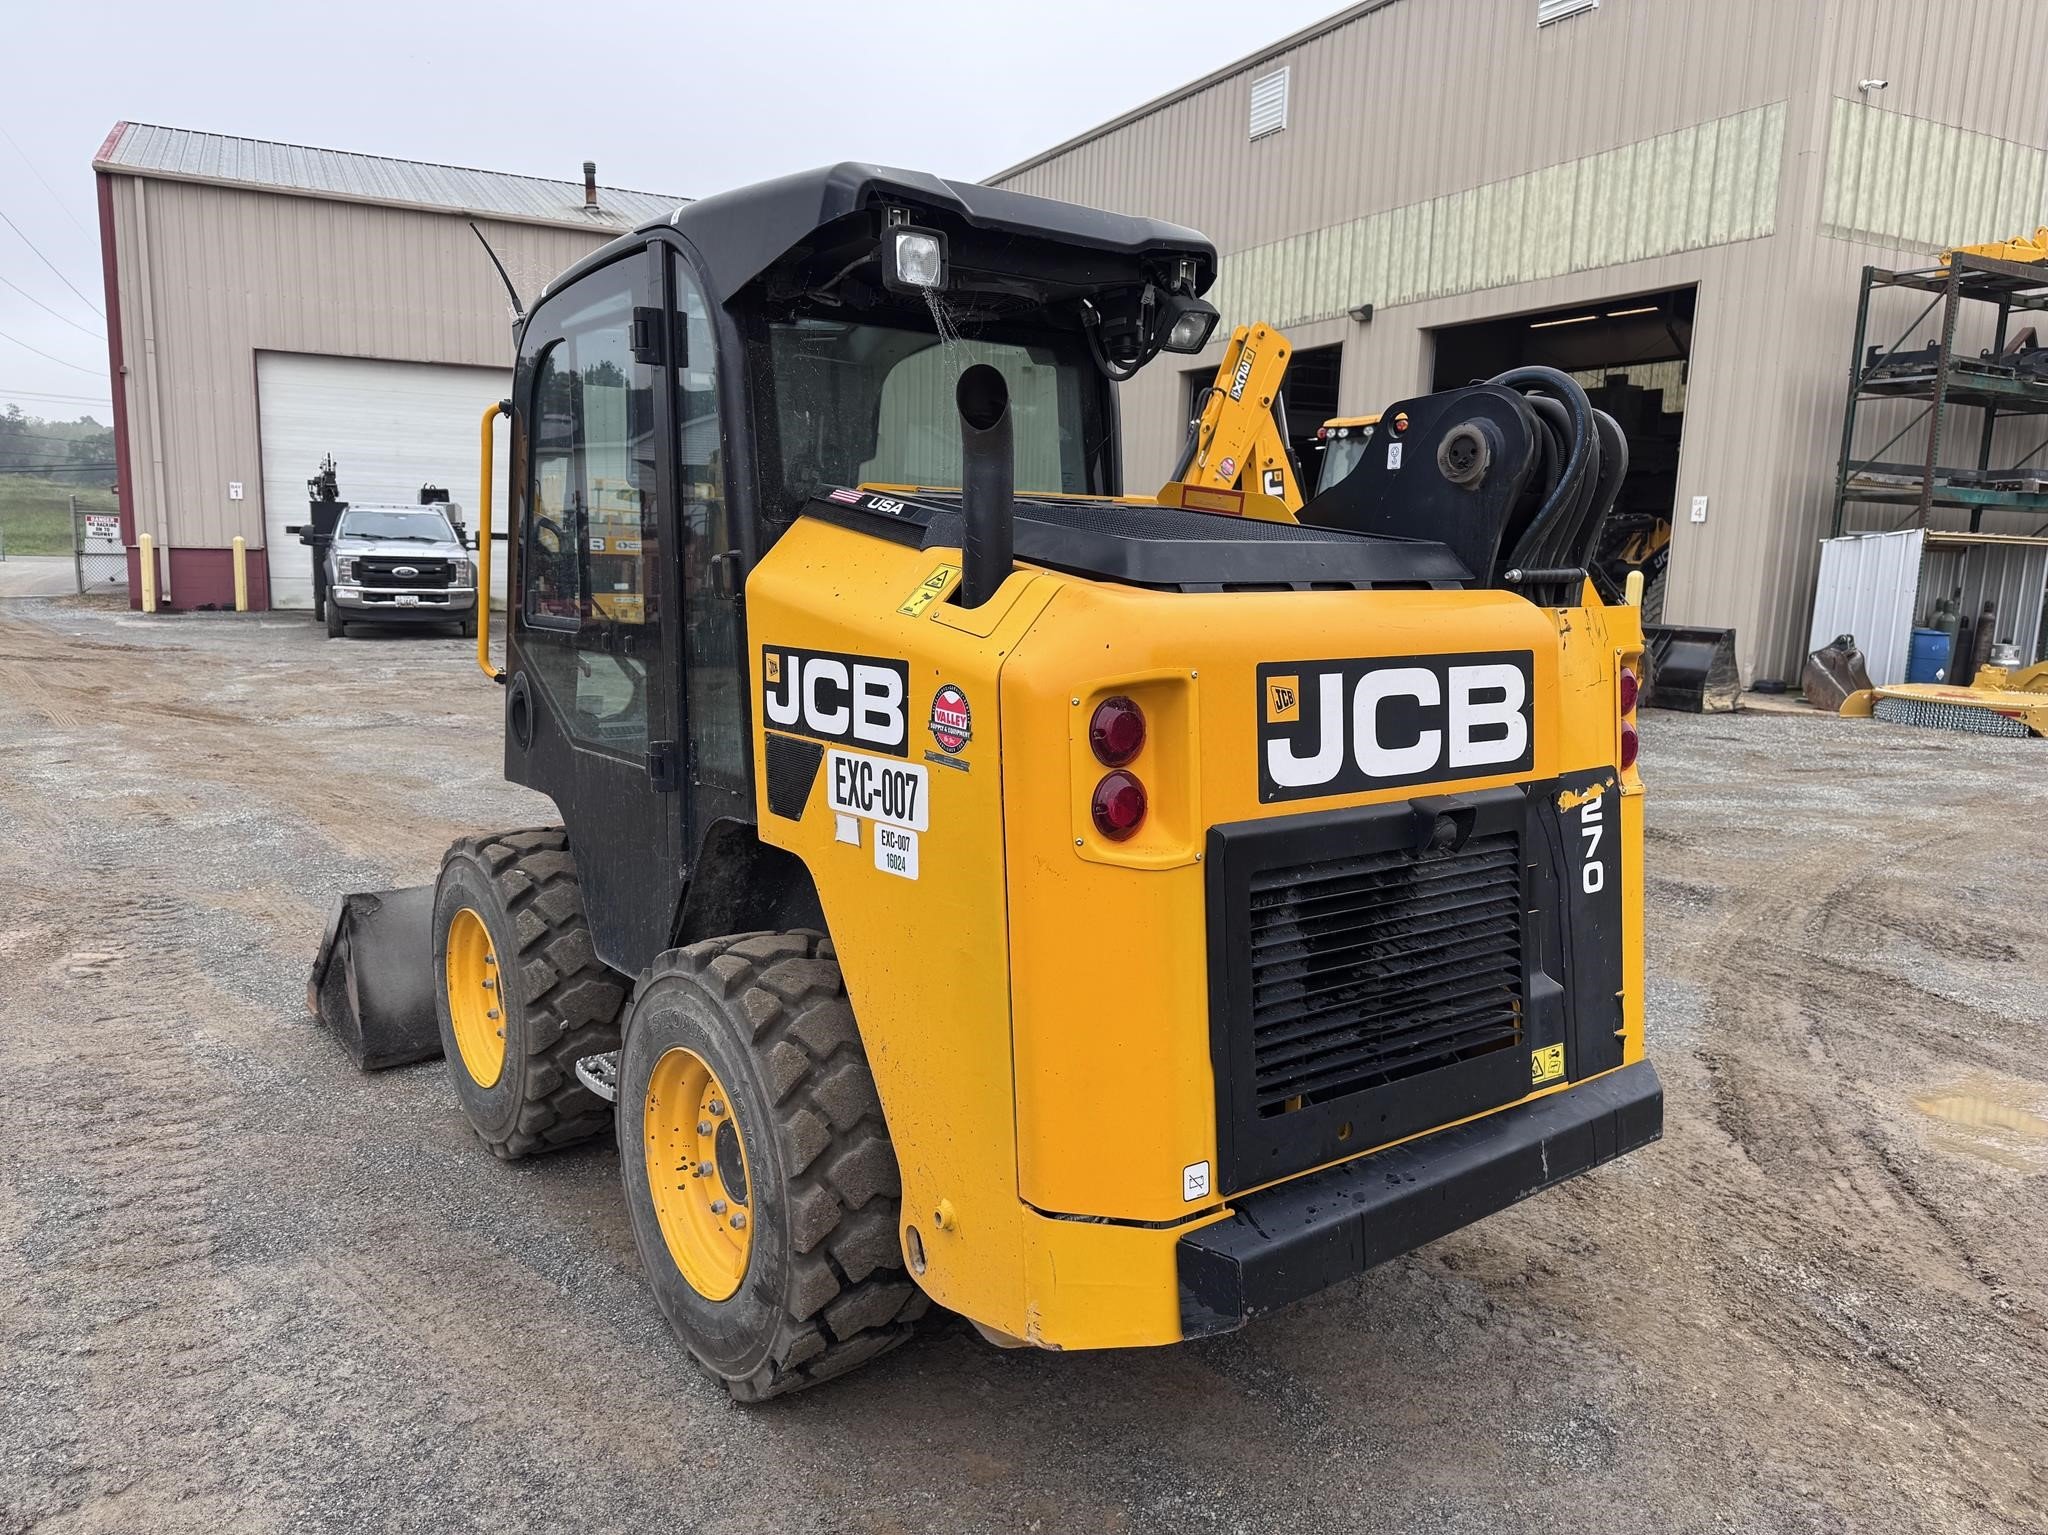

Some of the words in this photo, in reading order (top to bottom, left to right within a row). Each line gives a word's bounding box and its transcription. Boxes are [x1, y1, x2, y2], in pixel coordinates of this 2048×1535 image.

[867, 497, 905, 515] USA
[1695, 507, 1703, 518] 4
[766, 655, 904, 746] JCB
[1275, 688, 1294, 711] JCB
[936, 710, 966, 728] VALLEY
[1267, 664, 1528, 787] JCB
[835, 756, 918, 821] EXC-007
[881, 829, 911, 852] EXC-007
[1581, 794, 1604, 894] 270
[886, 852, 906, 872] 16024
